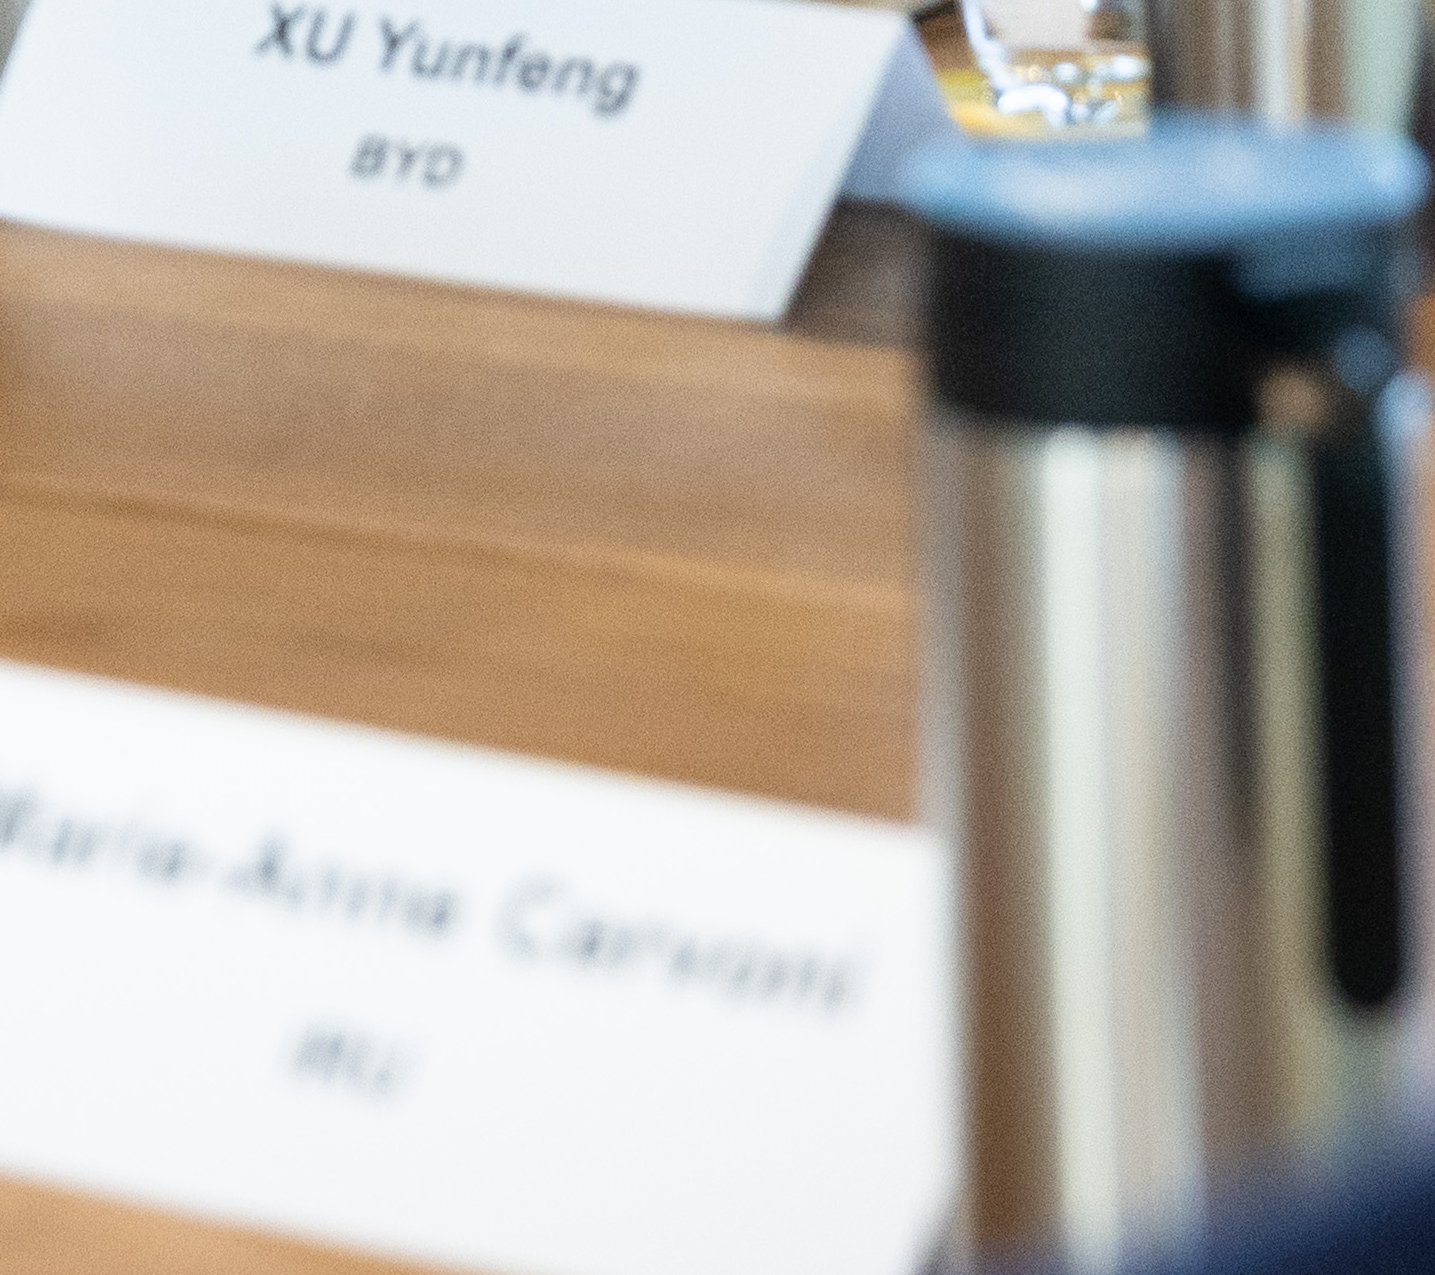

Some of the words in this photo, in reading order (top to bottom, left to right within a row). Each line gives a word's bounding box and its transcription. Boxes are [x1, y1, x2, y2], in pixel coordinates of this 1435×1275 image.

[254, 0, 360, 66] XU
[374, 17, 644, 119] Yunfeng
[349, 134, 465, 189] BYD
